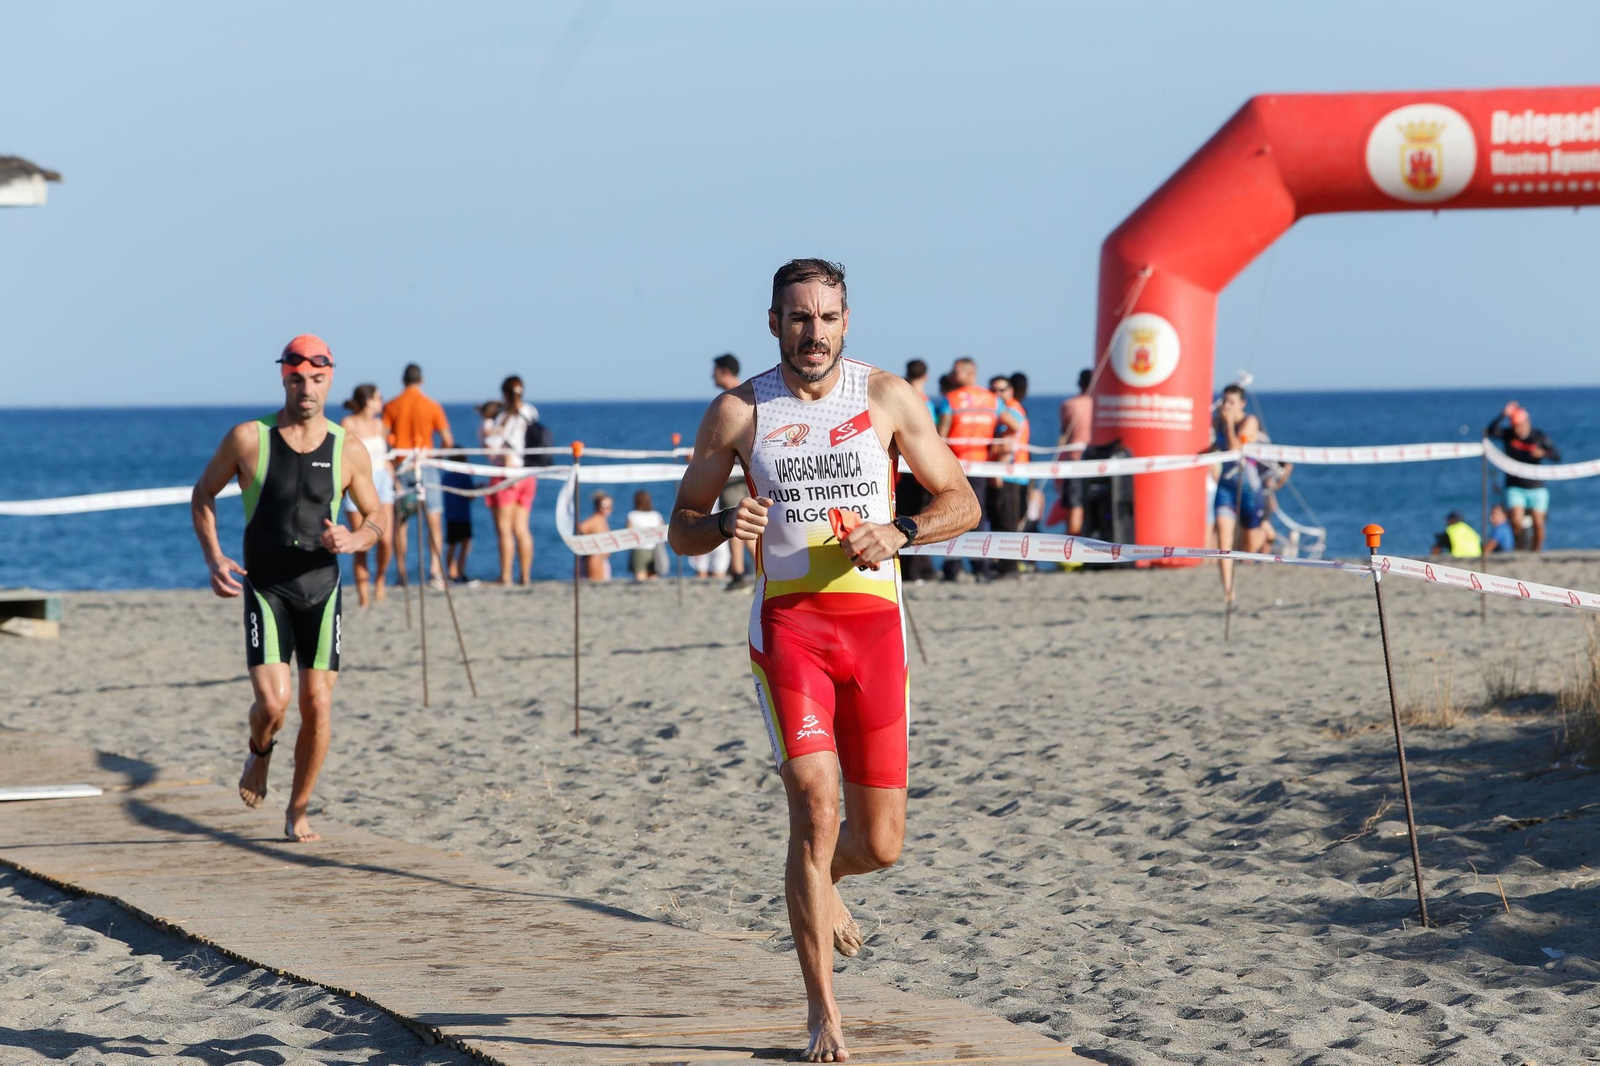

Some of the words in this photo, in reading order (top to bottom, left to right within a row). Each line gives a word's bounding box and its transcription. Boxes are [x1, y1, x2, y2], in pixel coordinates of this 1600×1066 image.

[774, 452, 862, 483] VARGAS-MACHUCA
[768, 489, 801, 503] CLUB
[805, 481, 878, 501] TRIATLON
